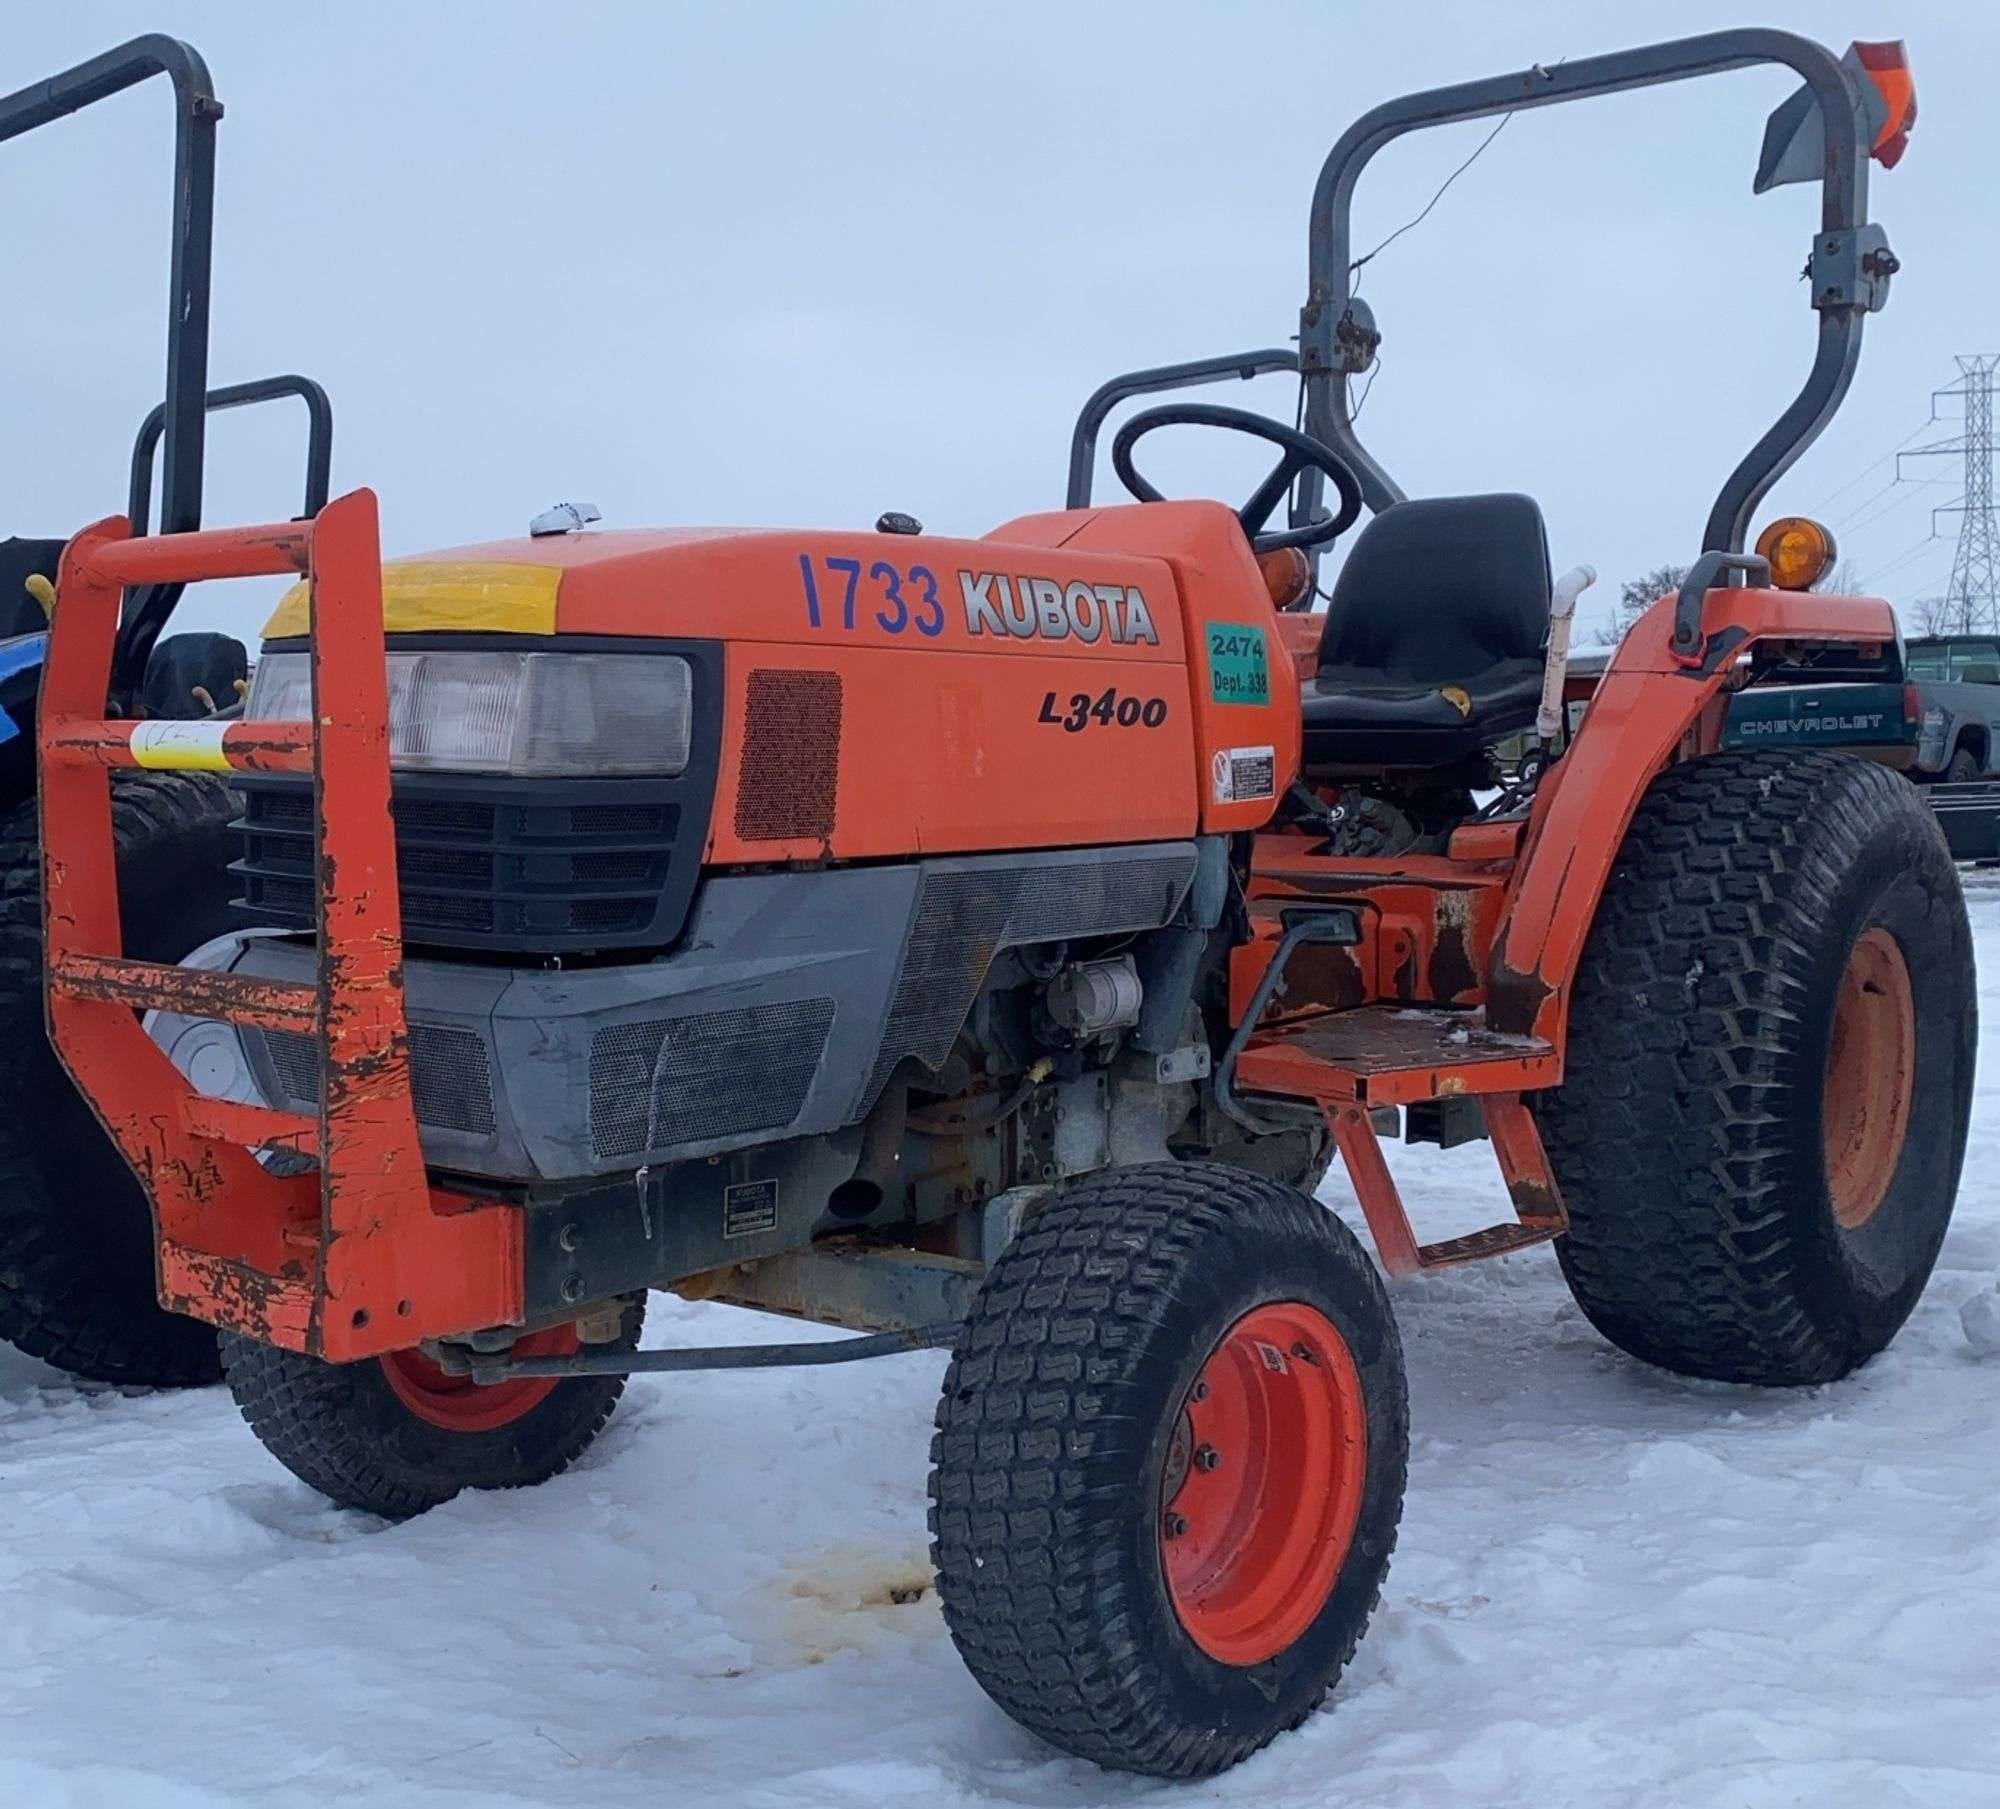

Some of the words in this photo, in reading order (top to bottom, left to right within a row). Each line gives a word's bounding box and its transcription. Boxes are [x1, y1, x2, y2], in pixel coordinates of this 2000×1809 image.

[799, 553, 945, 637] 1733
[958, 570, 1160, 645] KUBOTA
[1212, 634, 1264, 659] 2474
[1038, 687, 1168, 732] L3400
[1740, 714, 1883, 735] CHEVROLET
